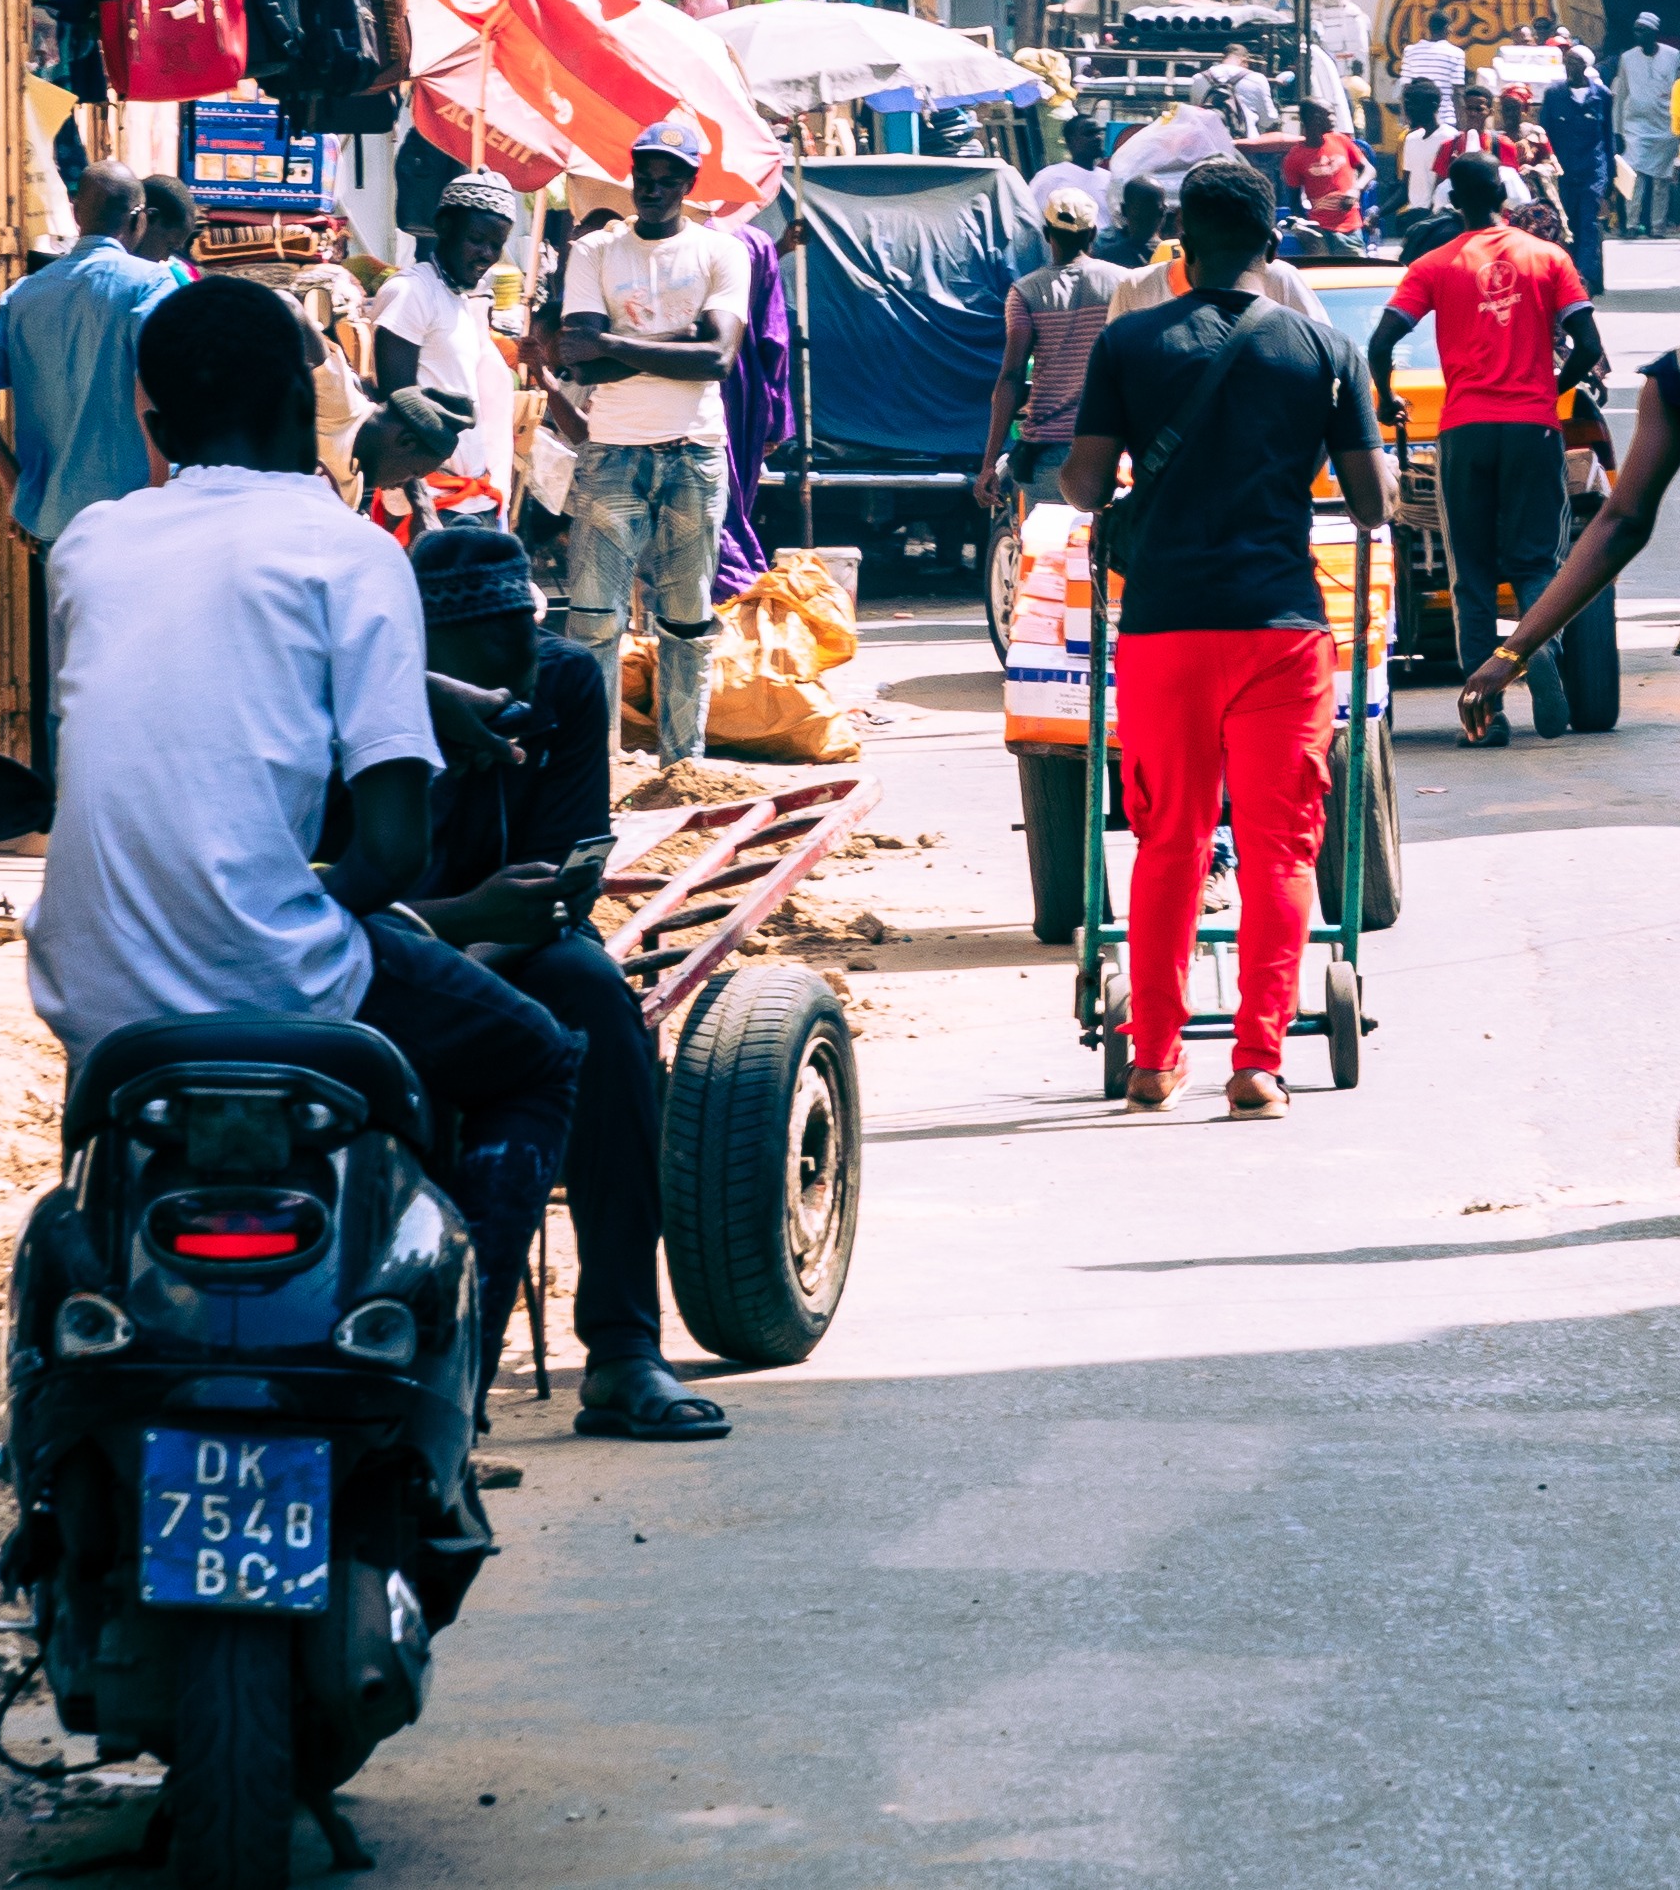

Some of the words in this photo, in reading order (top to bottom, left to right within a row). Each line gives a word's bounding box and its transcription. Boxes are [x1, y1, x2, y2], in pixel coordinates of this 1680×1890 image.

[196, 1440, 268, 1490] DK
[159, 1491, 314, 1549] 7548
[195, 1547, 278, 1601] BC
